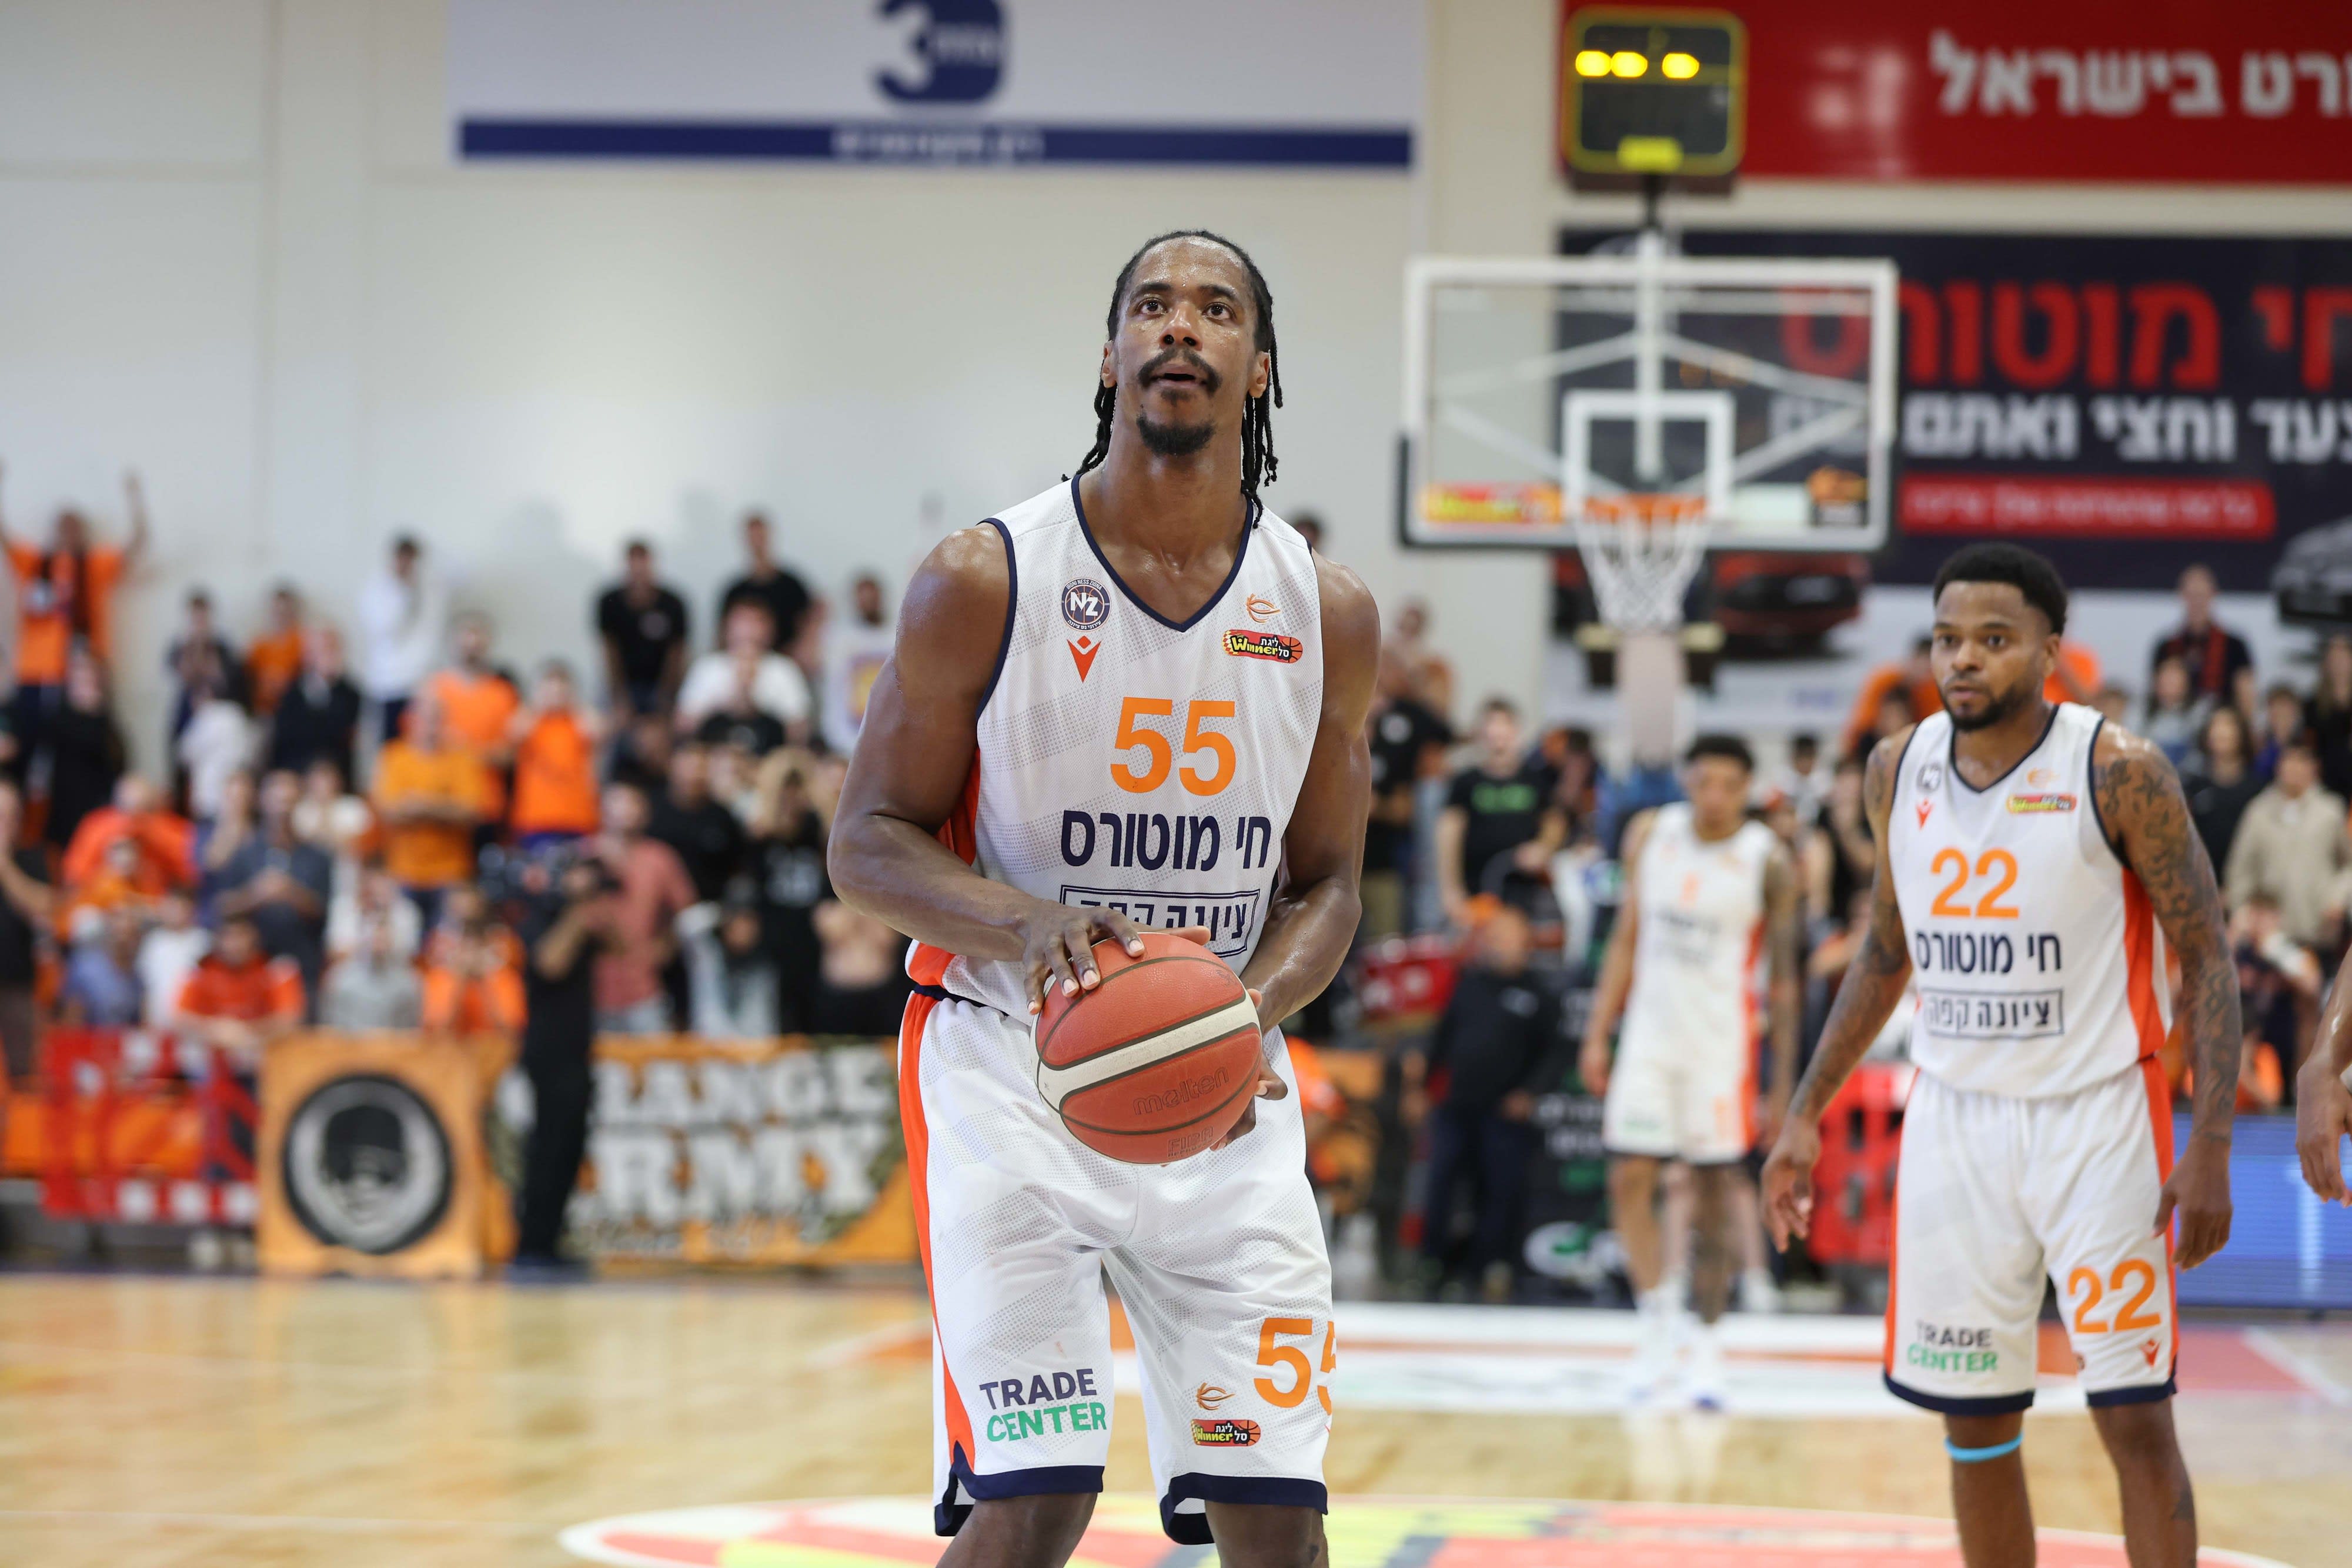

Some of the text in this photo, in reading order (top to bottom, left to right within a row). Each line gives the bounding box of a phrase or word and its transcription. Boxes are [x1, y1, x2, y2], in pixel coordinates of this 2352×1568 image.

[1930, 29, 2223, 115] בישראל
[1066, 581, 1078, 590] IRONI
[1090, 580, 1102, 590] ZIONA
[1070, 591, 1098, 617] NZ
[1231, 636, 1289, 657] Winner סל
[1260, 637, 1279, 646] ליגת
[1110, 697, 1236, 796] 55
[1061, 810, 1272, 871] חי מוטורס
[1930, 845, 2020, 920] 22
[1914, 931, 2062, 974] חי מוטורס
[1926, 999, 2050, 1032] ציונה קפה
[1132, 1066, 1229, 1115] molten
[2067, 1258, 2161, 1333] 22
[1915, 1319, 1992, 1347] TRADE
[1907, 1342, 1997, 1372] CENTER
[980, 1368, 1098, 1410] TRADE
[986, 1402, 1107, 1442] CENTER
[1215, 1422, 1234, 1433] ליגת
[1234, 1430, 1248, 1441] סל
